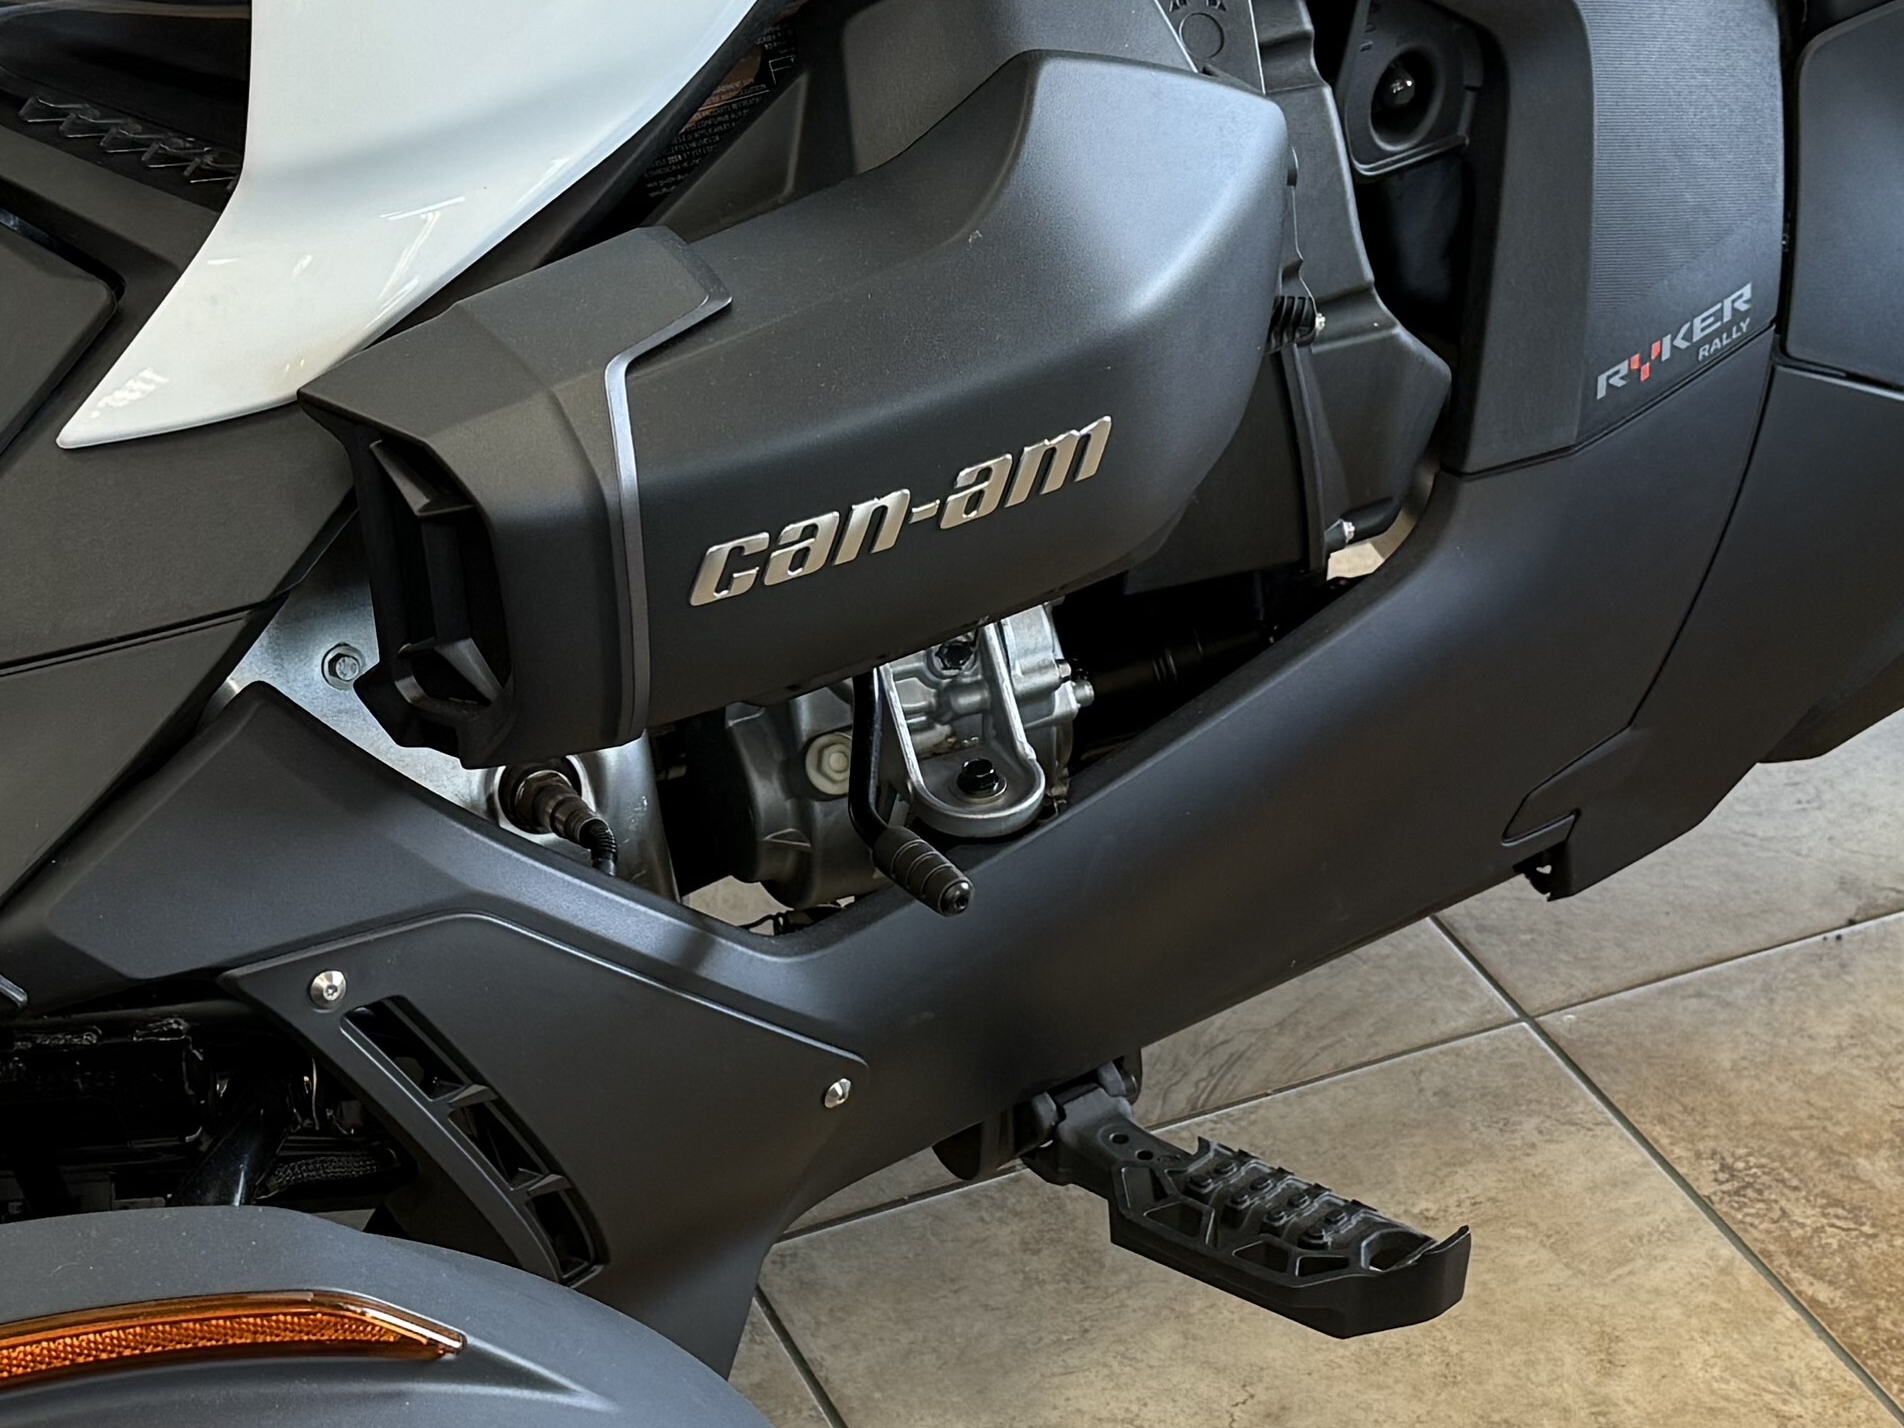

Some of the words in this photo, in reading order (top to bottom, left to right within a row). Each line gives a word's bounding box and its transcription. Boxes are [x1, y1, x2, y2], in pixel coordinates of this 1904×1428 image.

[1596, 281, 1753, 401] RYKER
[1698, 317, 1751, 362] RALLY
[690, 414, 1113, 606] can-am
